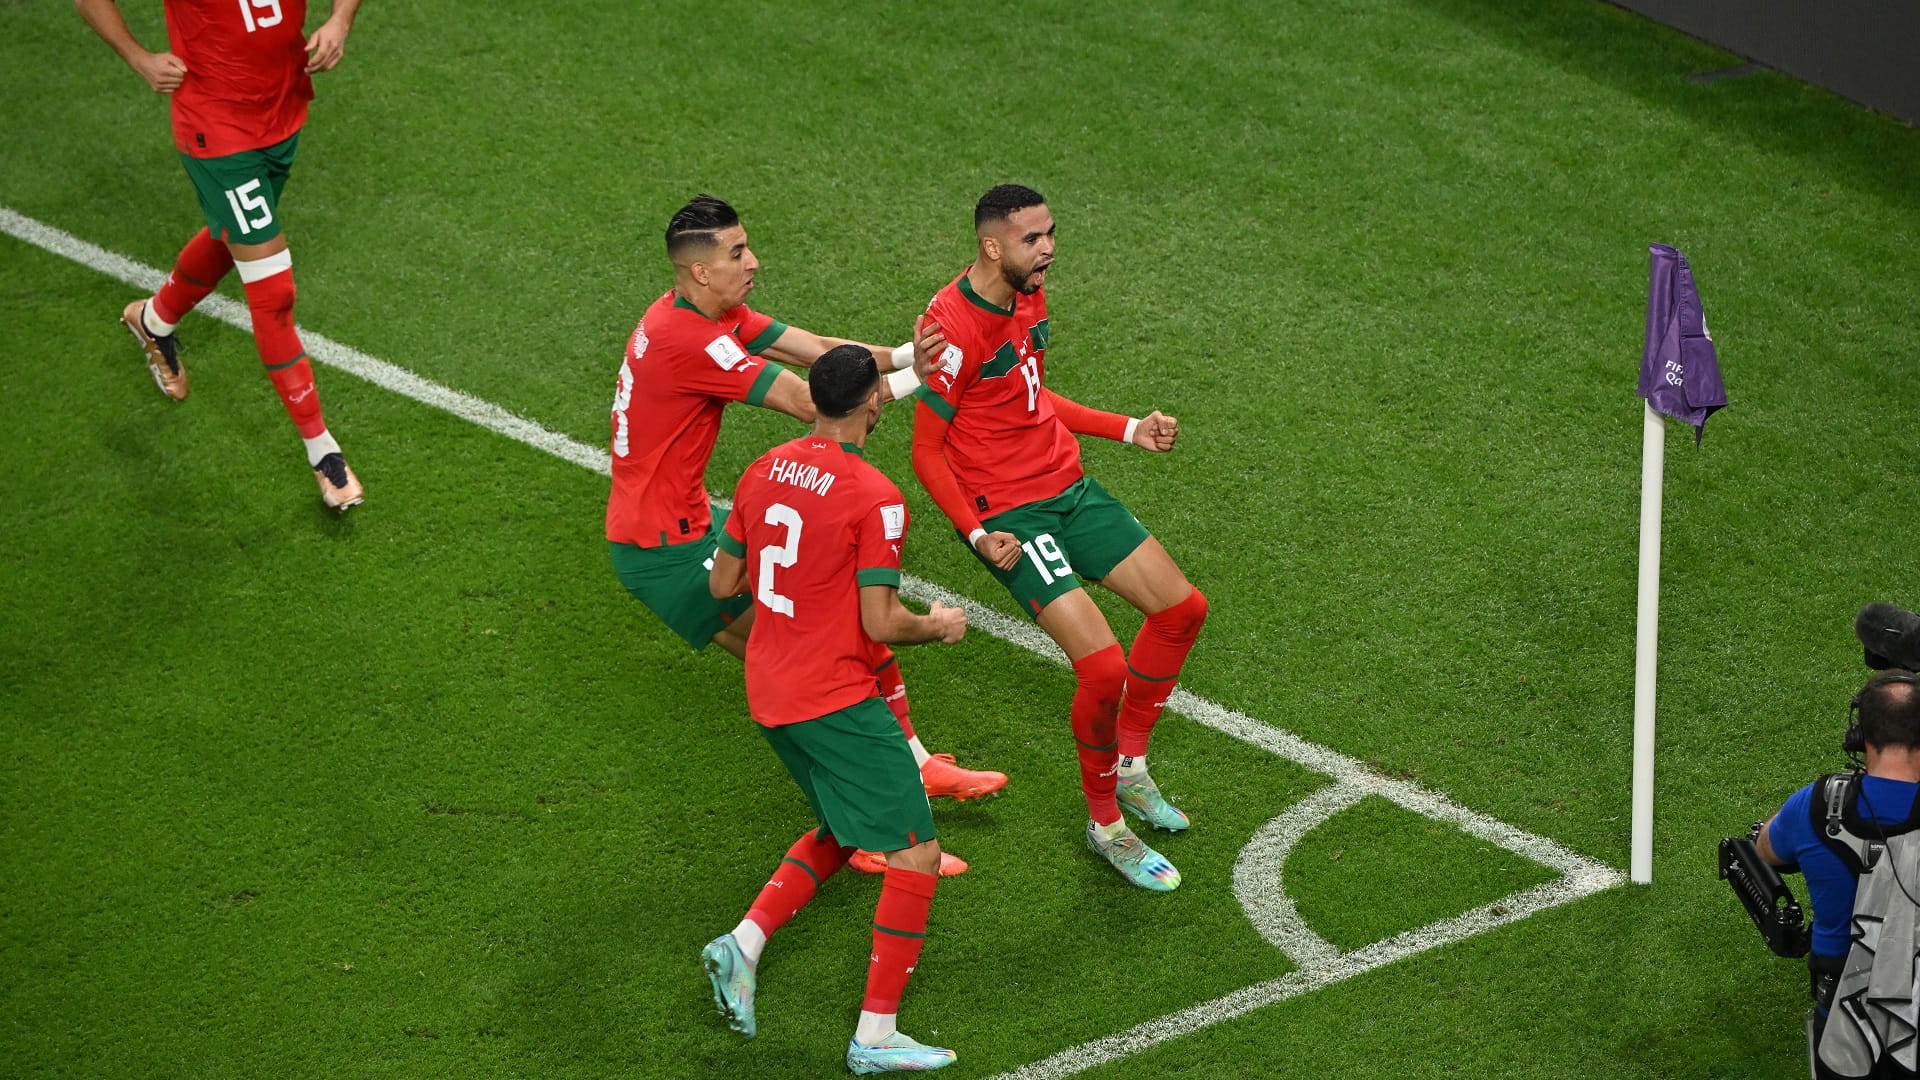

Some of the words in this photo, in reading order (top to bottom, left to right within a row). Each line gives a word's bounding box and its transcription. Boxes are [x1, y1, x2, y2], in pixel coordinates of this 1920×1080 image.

[225, 178, 273, 235] 15
[768, 457, 836, 497] HAKIMI
[757, 503, 803, 618] 2
[1021, 533, 1073, 586] 19
